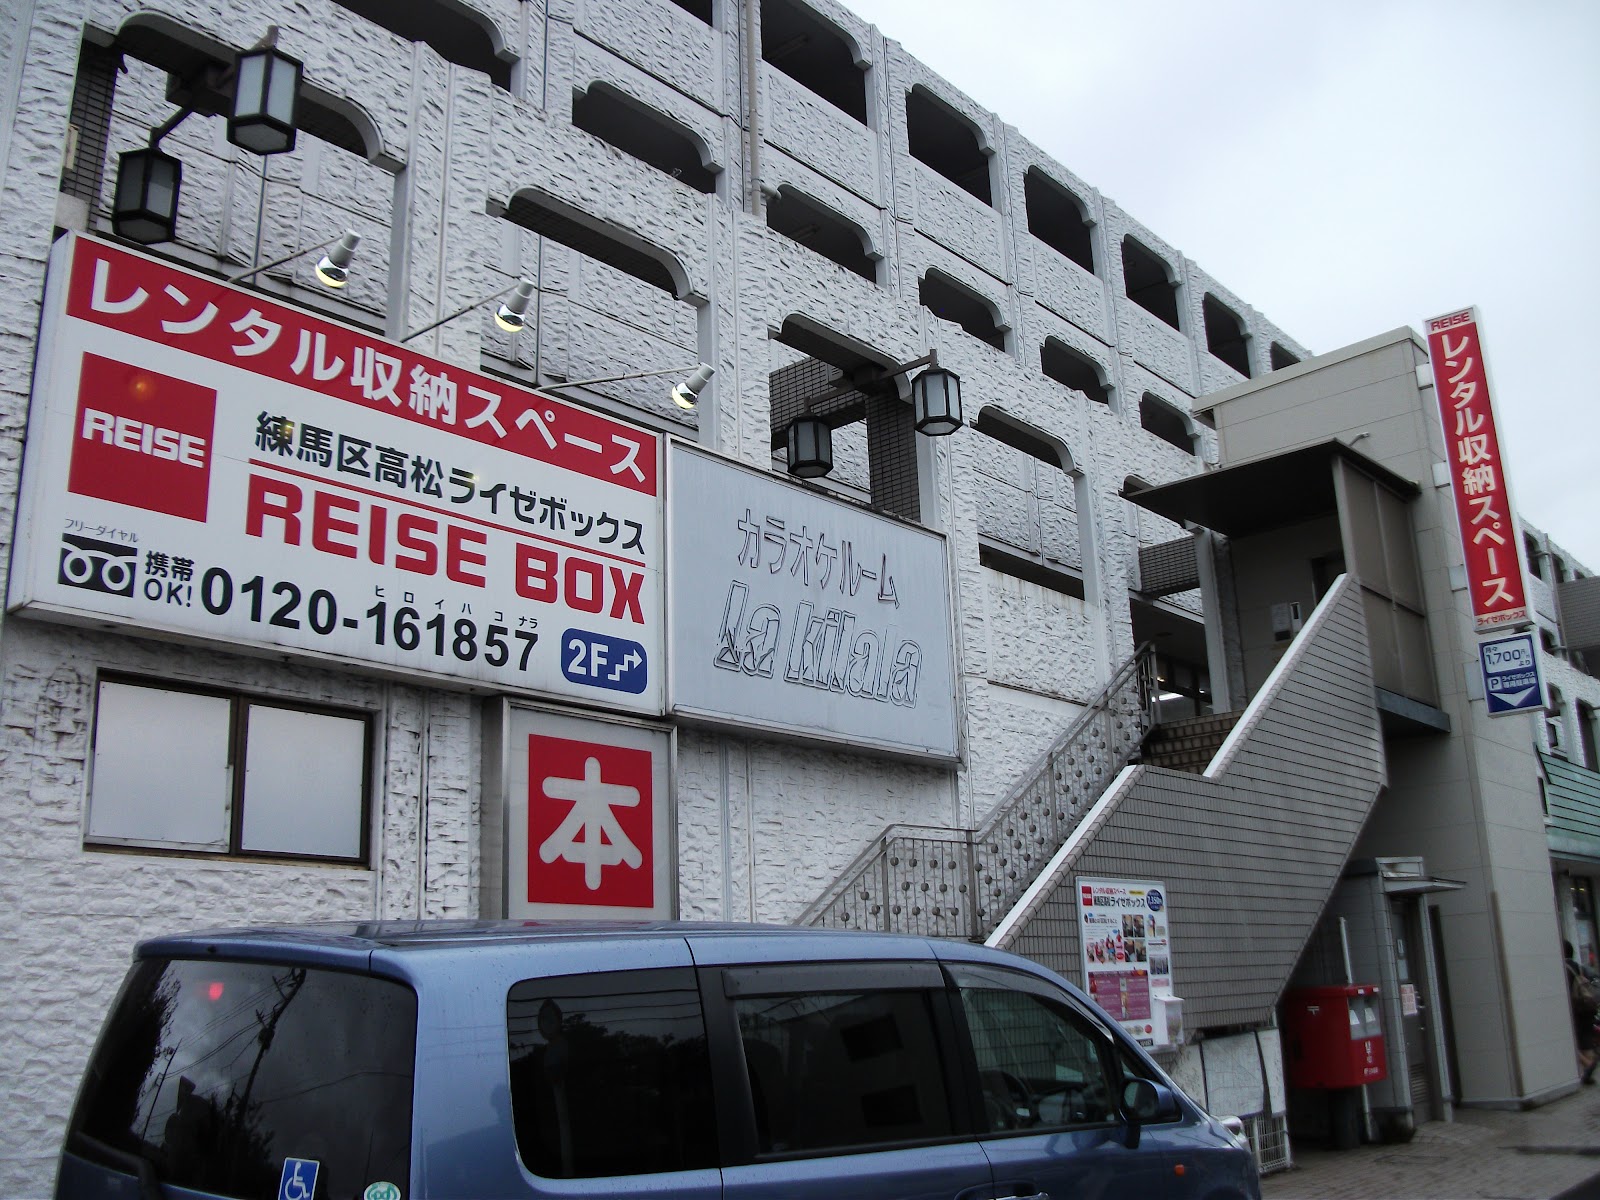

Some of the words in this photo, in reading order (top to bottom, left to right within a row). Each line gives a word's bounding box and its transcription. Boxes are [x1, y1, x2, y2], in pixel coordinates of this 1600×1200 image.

[92, 257, 647, 483] レンタル収納スペース
[1431, 311, 1470, 332] REISE
[82, 407, 206, 468] REISE
[256, 411, 645, 555] 練馬区高松ライゼボックス
[1441, 333, 1514, 608] レンタル収納スペース
[64, 518, 139, 543] フリーダイヤル
[144, 550, 195, 582] 携帯
[245, 473, 488, 589] REISE
[515, 542, 645, 625] BOX
[737, 508, 900, 610] カラオケルーム
[144, 578, 192, 607] OK!
[201, 566, 539, 672] 0120-161857
[567, 638, 609, 678] 2F
[539, 756, 643, 891] 本
